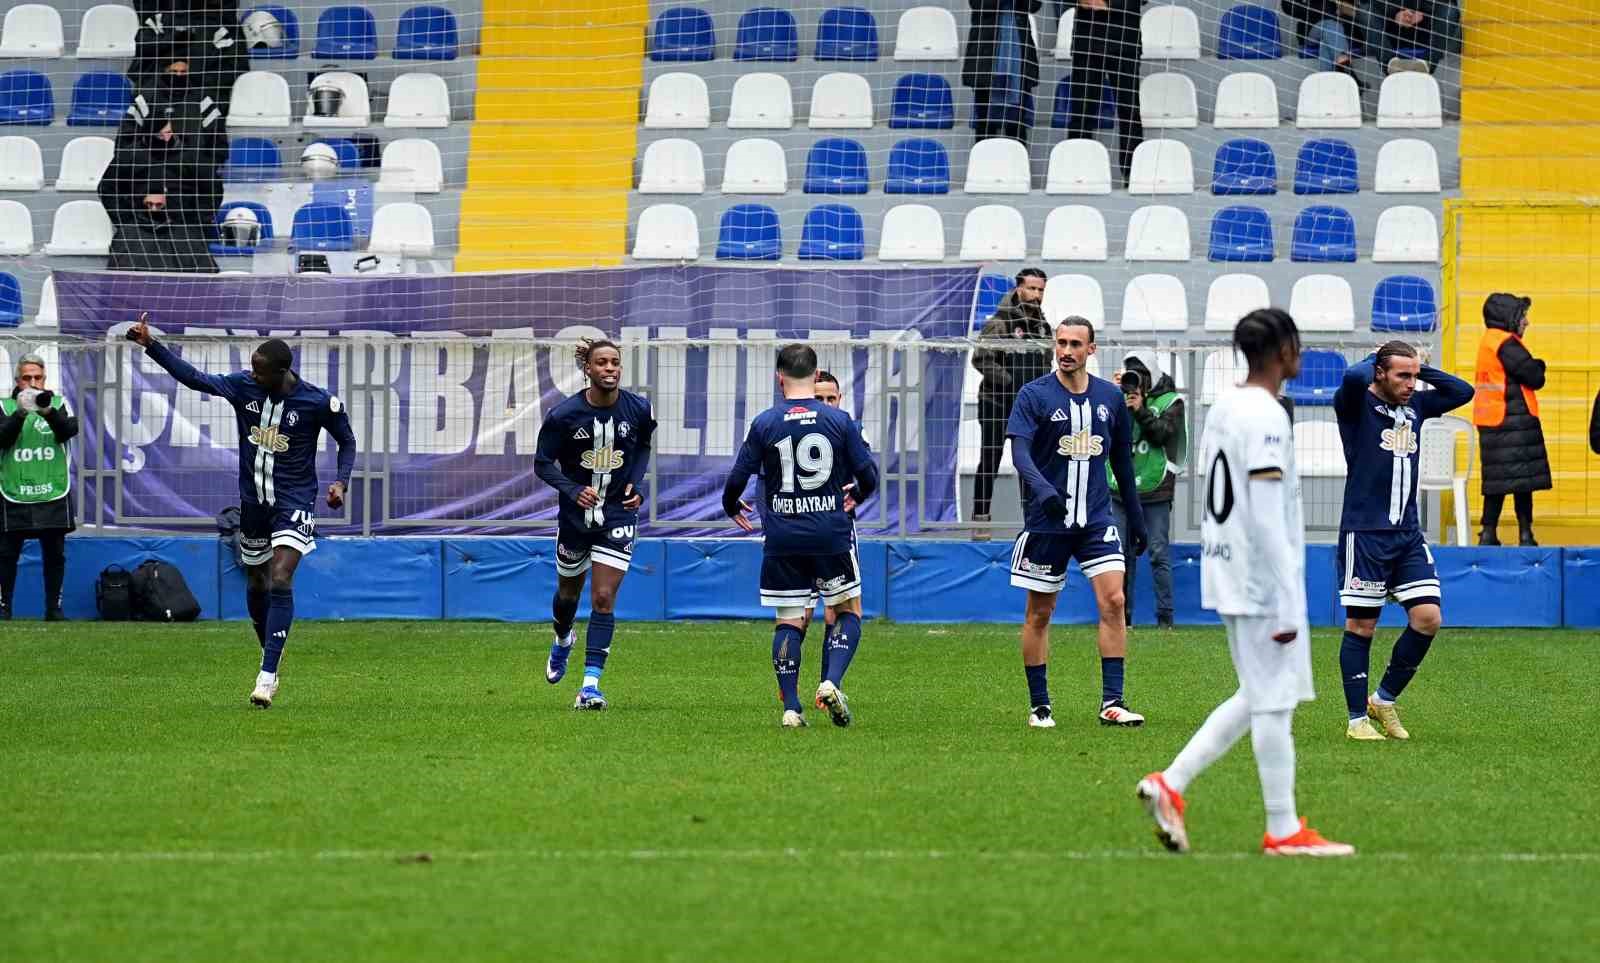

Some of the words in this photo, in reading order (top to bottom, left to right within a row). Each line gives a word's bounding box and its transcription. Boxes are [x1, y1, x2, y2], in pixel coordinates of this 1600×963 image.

[774, 432, 834, 492] 19
[20, 482, 54, 495] PRESS
[772, 494, 794, 513] ÖMER
[795, 495, 836, 513] BAYRAM
